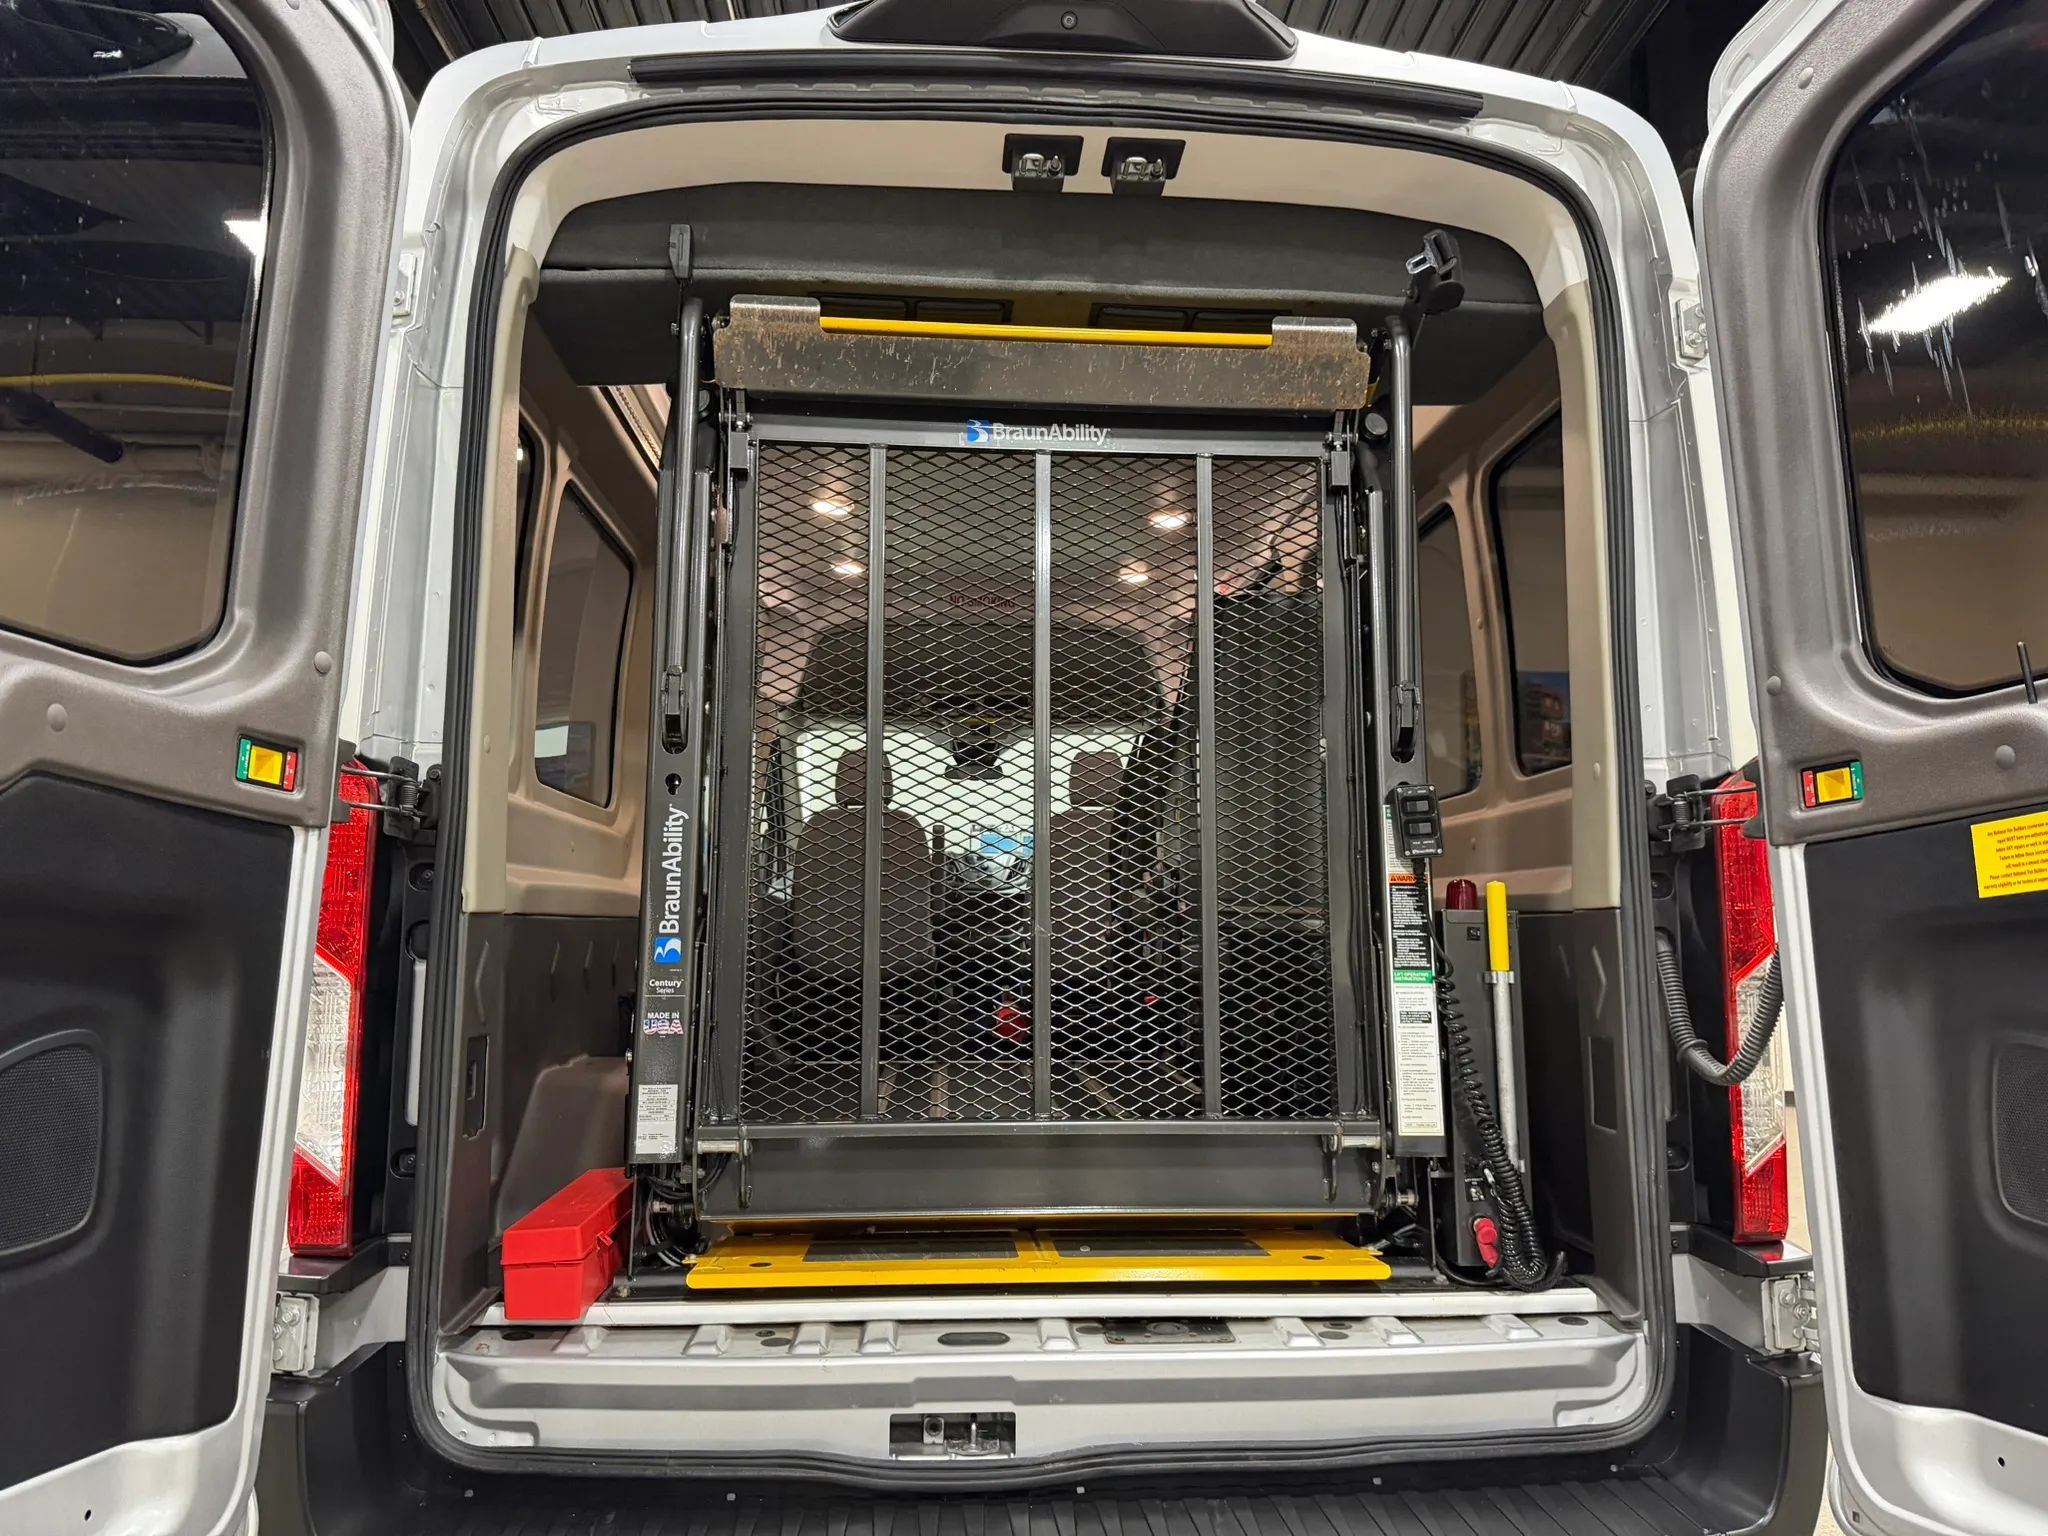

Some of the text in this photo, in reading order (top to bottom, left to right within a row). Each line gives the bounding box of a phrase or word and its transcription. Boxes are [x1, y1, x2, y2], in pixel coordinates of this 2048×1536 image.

[992, 422, 1107, 446] BraunAbility
[659, 806, 690, 934] BraunAbility
[649, 979, 682, 988] Century
[671, 1011, 680, 1019] IN
[643, 1019, 684, 1035] USA
